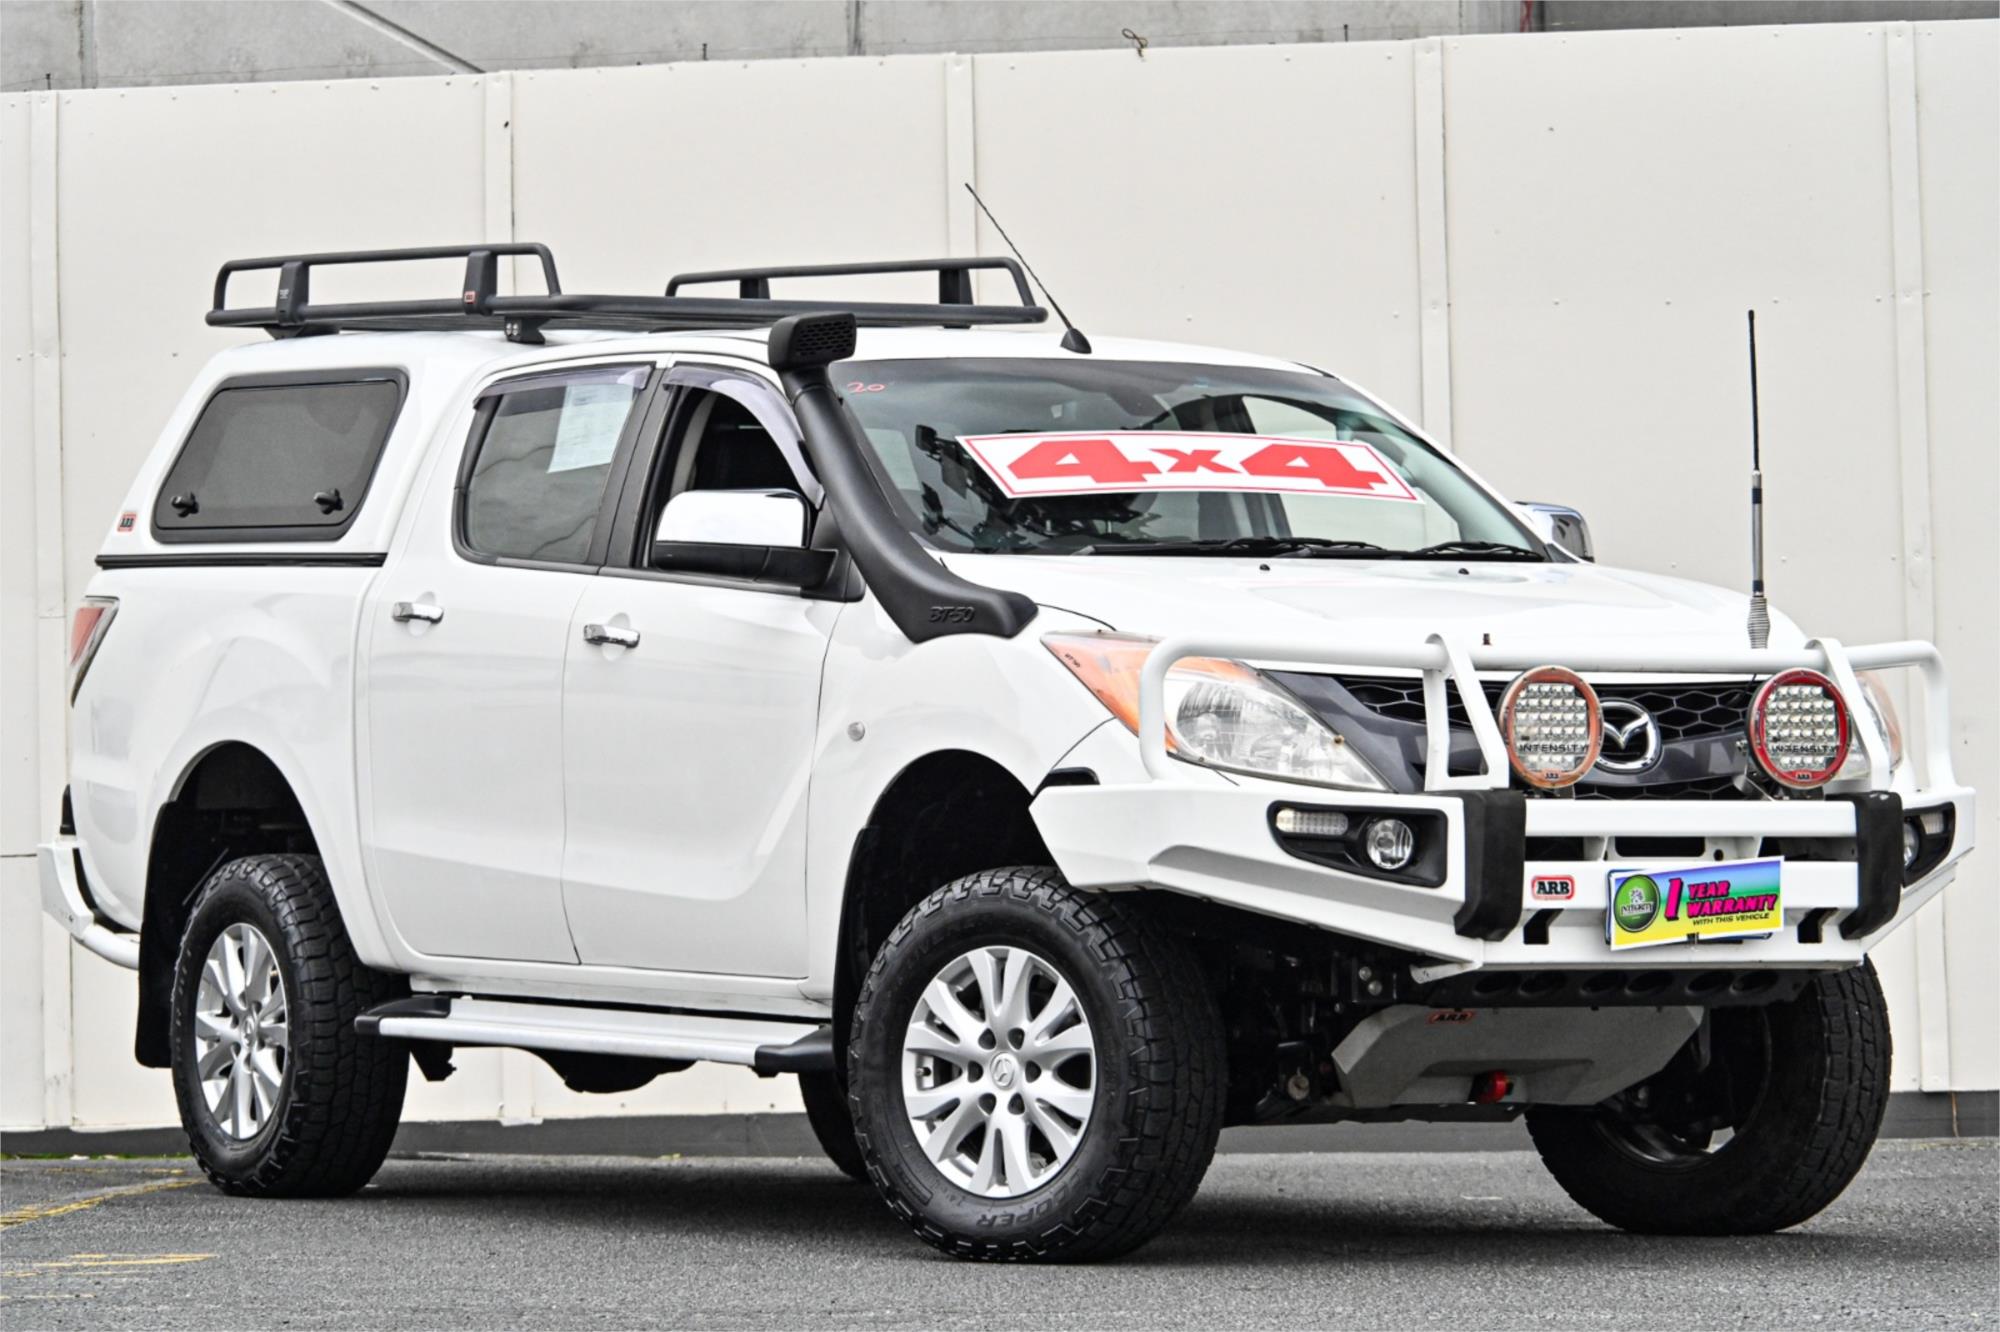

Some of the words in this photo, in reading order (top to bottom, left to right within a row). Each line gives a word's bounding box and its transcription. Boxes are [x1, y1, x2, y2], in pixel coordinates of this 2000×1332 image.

[928, 606, 976, 623] BT-50
[1519, 743, 1589, 754] INTENSITY
[1536, 880, 1570, 895] ARB
[1687, 880, 1731, 900] YEAR
[1664, 877, 1684, 921] 1
[1686, 893, 1778, 919] WARRANTY
[1693, 918, 1714, 926] WITH
[1715, 915, 1735, 923] THIS
[1736, 912, 1770, 922] VEHICLE
